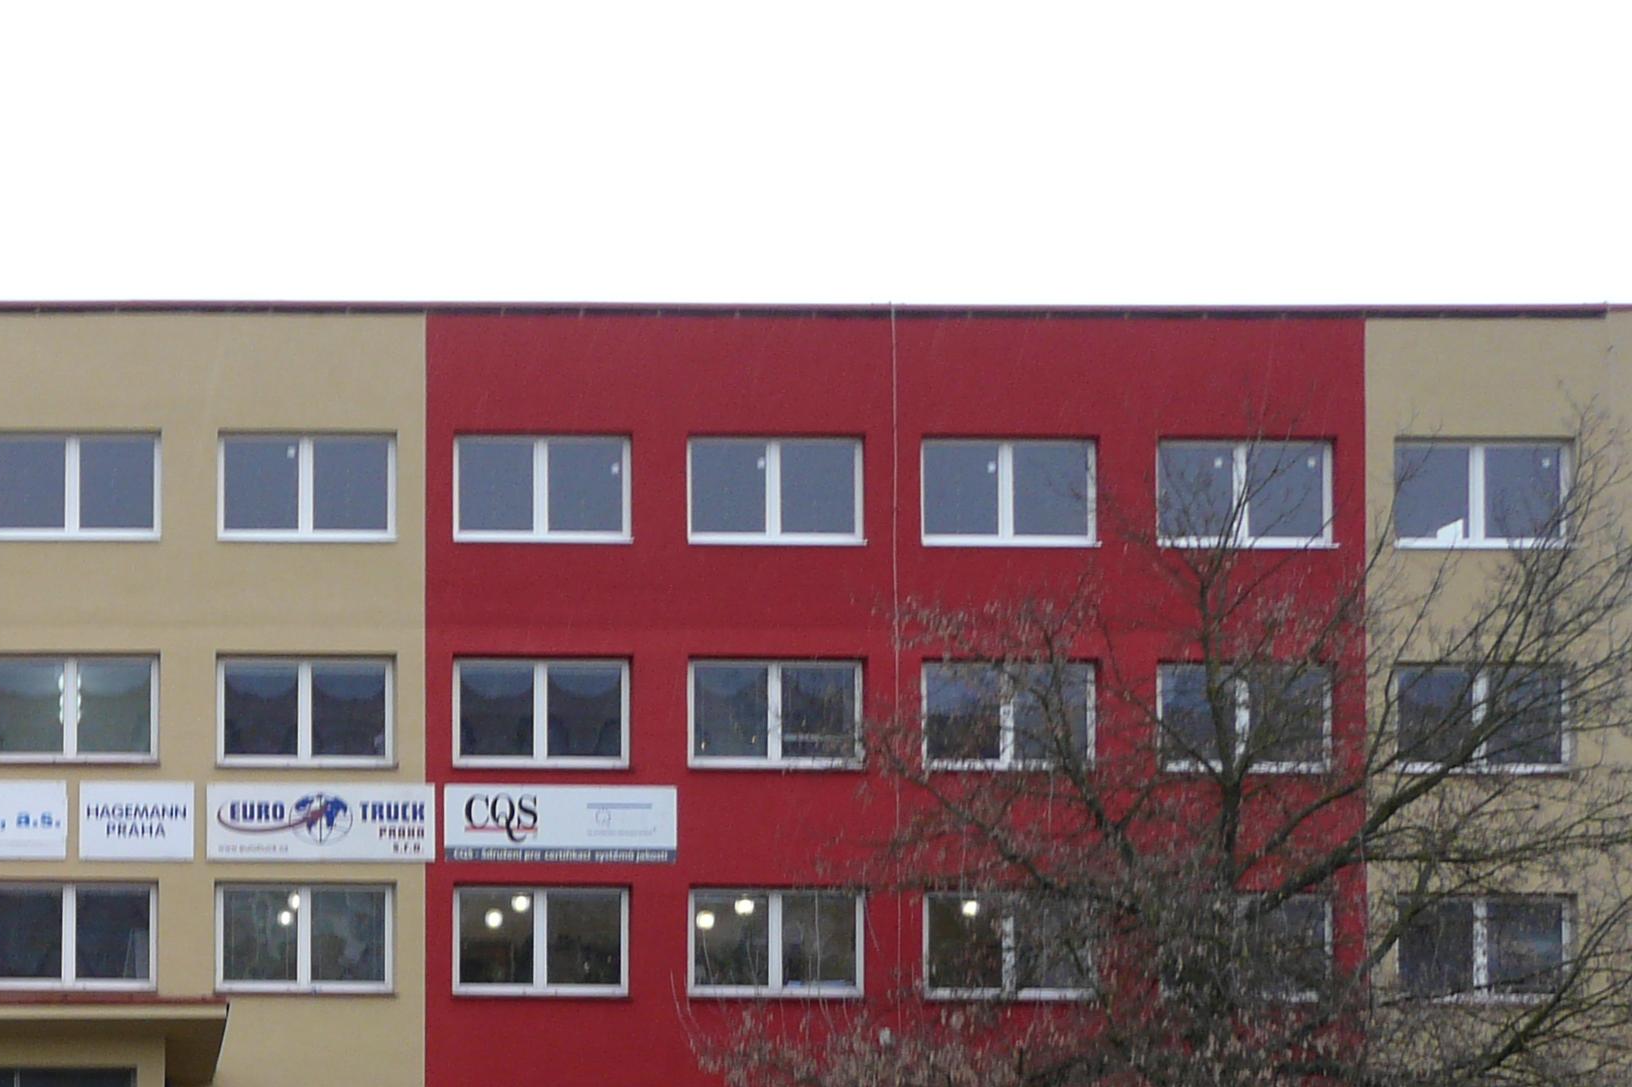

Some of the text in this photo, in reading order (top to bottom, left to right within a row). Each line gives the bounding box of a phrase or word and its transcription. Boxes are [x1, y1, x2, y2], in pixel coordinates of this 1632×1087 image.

[16, 807, 61, 828] a.s.
[85, 804, 187, 821] HAGEMANN
[229, 801, 426, 823] EURO TRUCK
[464, 793, 538, 843] CQS
[105, 822, 167, 839] PRAHA
[524, 850, 542, 863] pro
